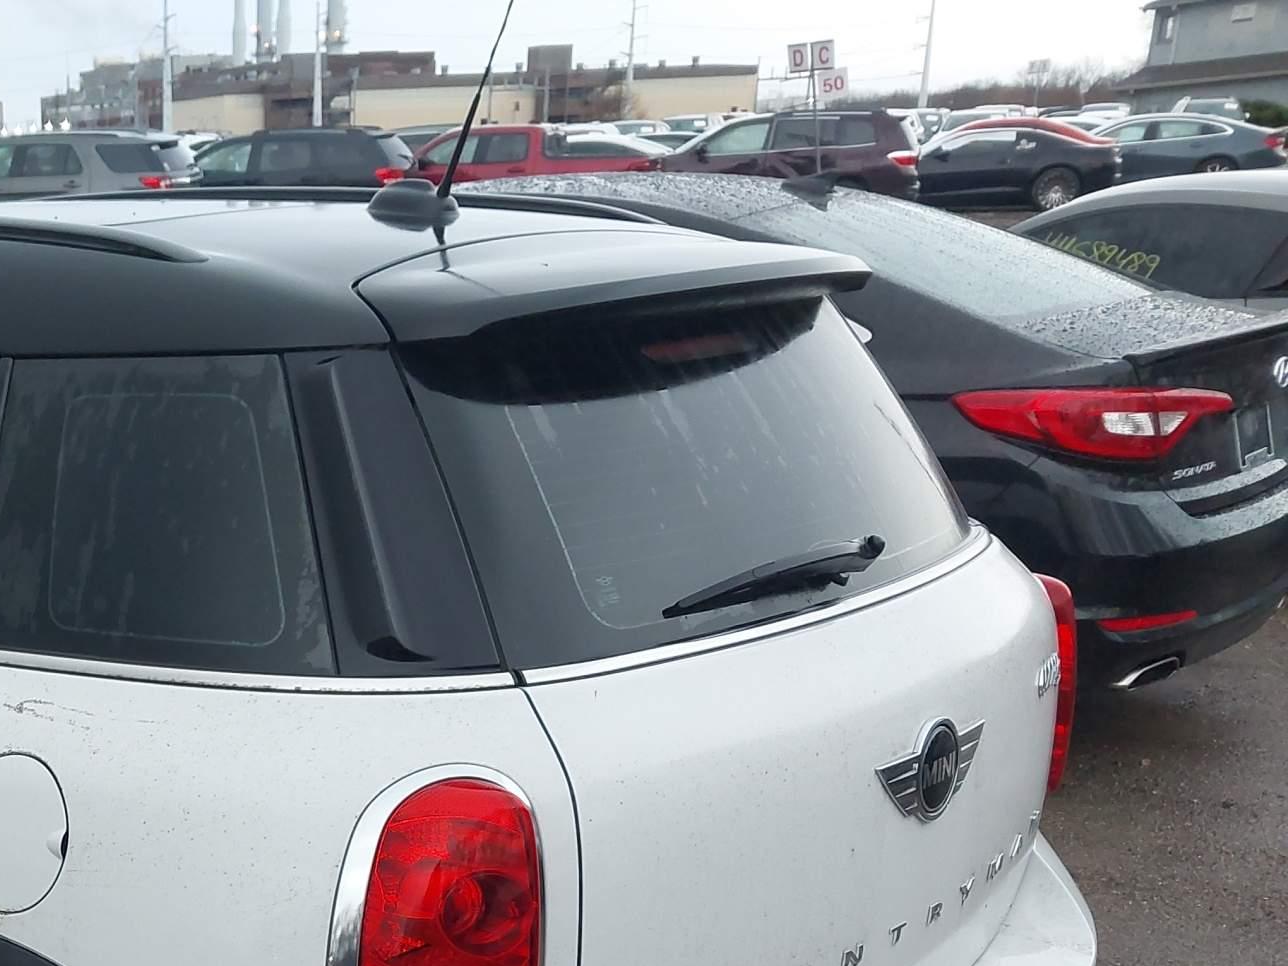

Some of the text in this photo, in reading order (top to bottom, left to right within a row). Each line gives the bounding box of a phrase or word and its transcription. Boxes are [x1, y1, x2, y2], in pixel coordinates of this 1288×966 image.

[792, 49, 804, 67] D
[818, 46, 830, 64] C
[823, 76, 844, 93] 50
[922, 750, 957, 790] MINI
